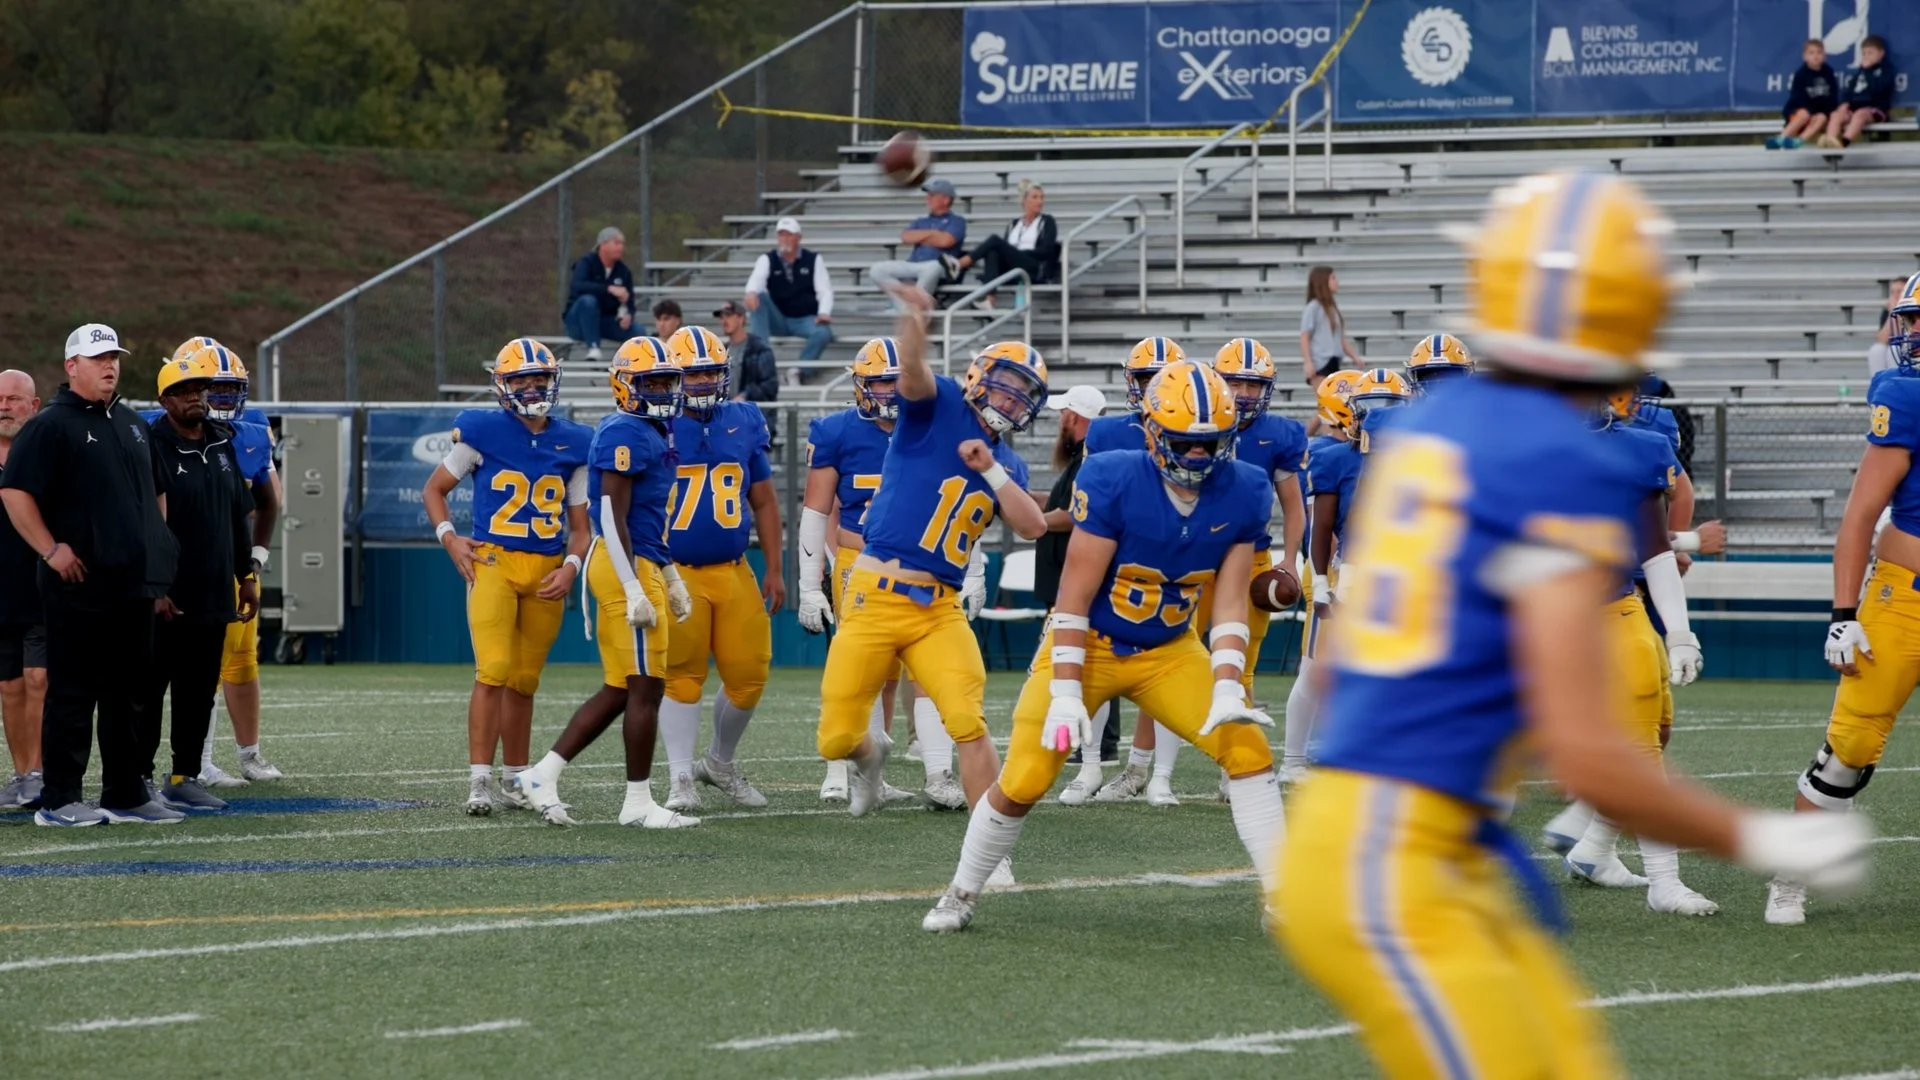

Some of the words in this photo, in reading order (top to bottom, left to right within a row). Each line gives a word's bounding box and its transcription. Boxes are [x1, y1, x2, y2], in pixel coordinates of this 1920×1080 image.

[1156, 26, 1331, 48] Chattanooga
[1581, 25, 1638, 41] BLEVINS
[1581, 41, 1699, 60] CONSTRUCTION
[976, 53, 1139, 104] SUPREME
[1580, 58, 1691, 77] MANAGEMENT,
[1694, 56, 1726, 73] INC.
[615, 446, 630, 471] 8
[488, 469, 566, 540] 29
[671, 462, 744, 530] 78
[918, 475, 995, 570] 18
